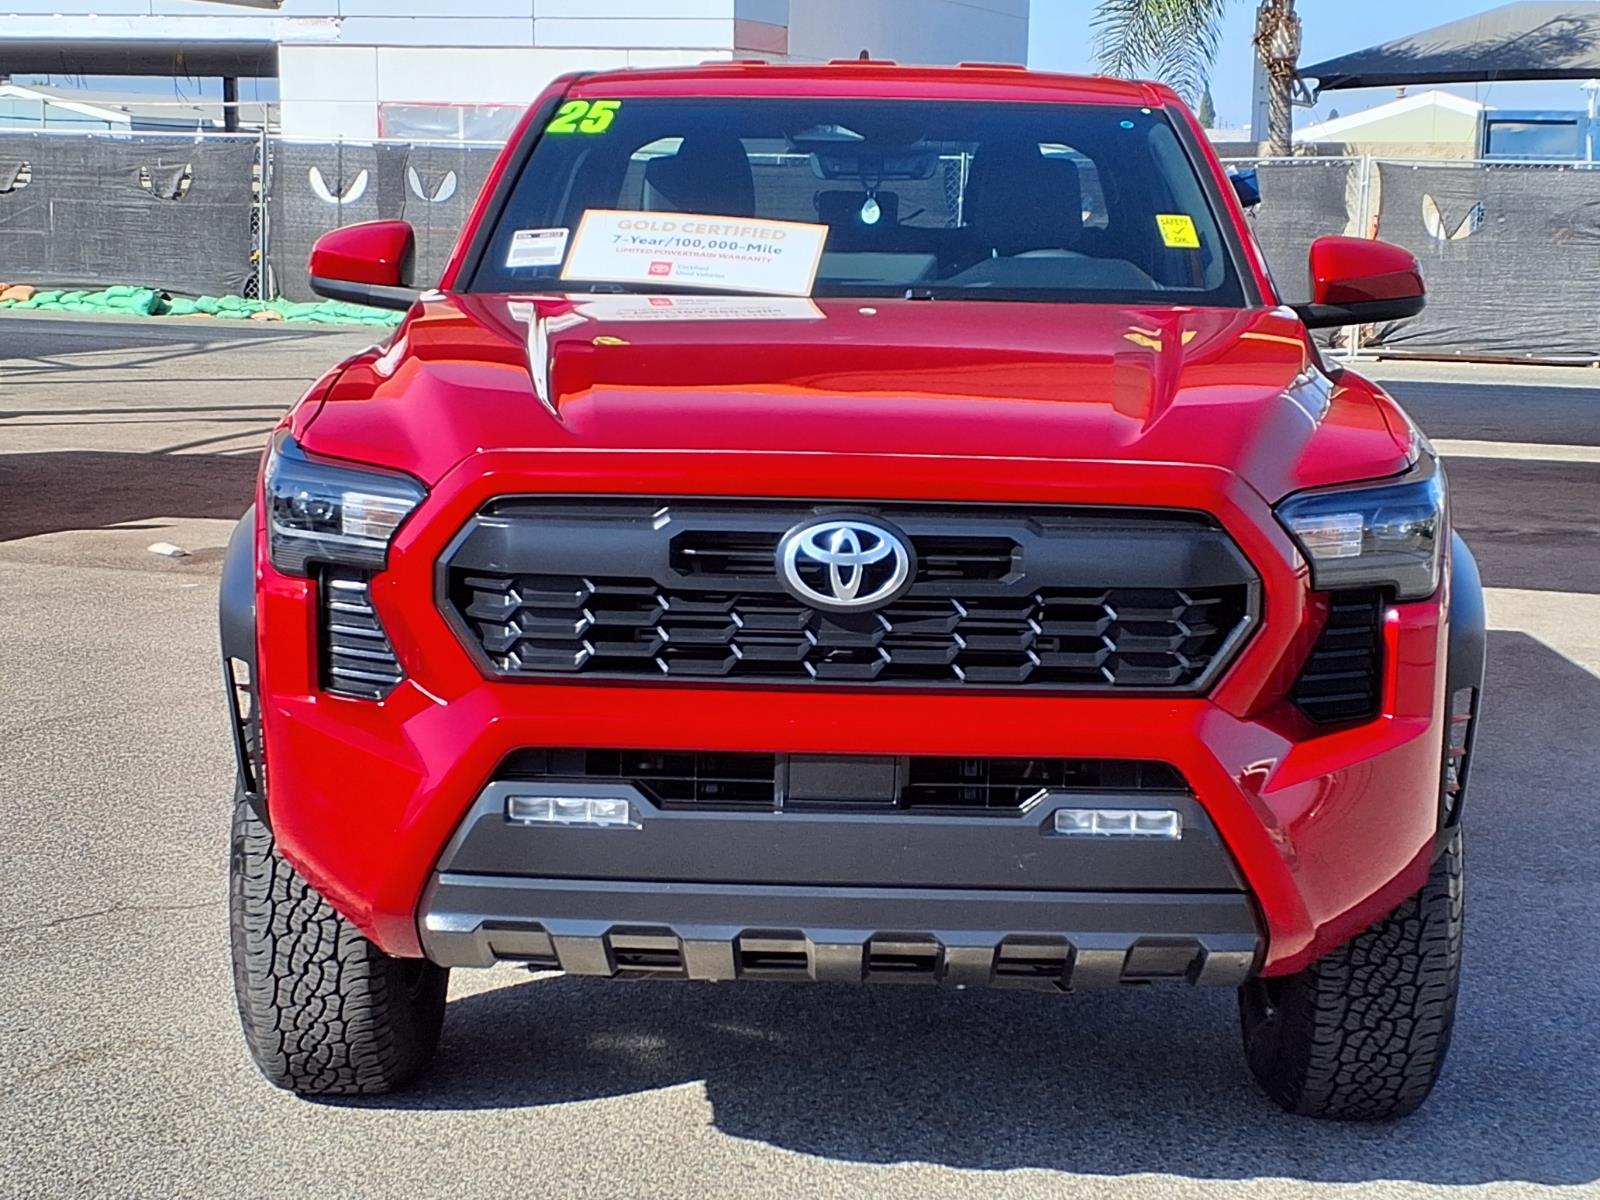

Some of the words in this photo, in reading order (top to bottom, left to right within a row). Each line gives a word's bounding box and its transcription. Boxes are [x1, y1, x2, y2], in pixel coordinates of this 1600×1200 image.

[546, 100, 622, 134] 25
[617, 219, 678, 232] GOLD
[681, 222, 787, 240] CERTIFIED
[1160, 218, 1189, 226] SAFETY
[612, 234, 783, 255] 7-Year/100,000-Mile
[653, 249, 717, 258] POWERTRAIN
[718, 252, 773, 263] WARRANTY
